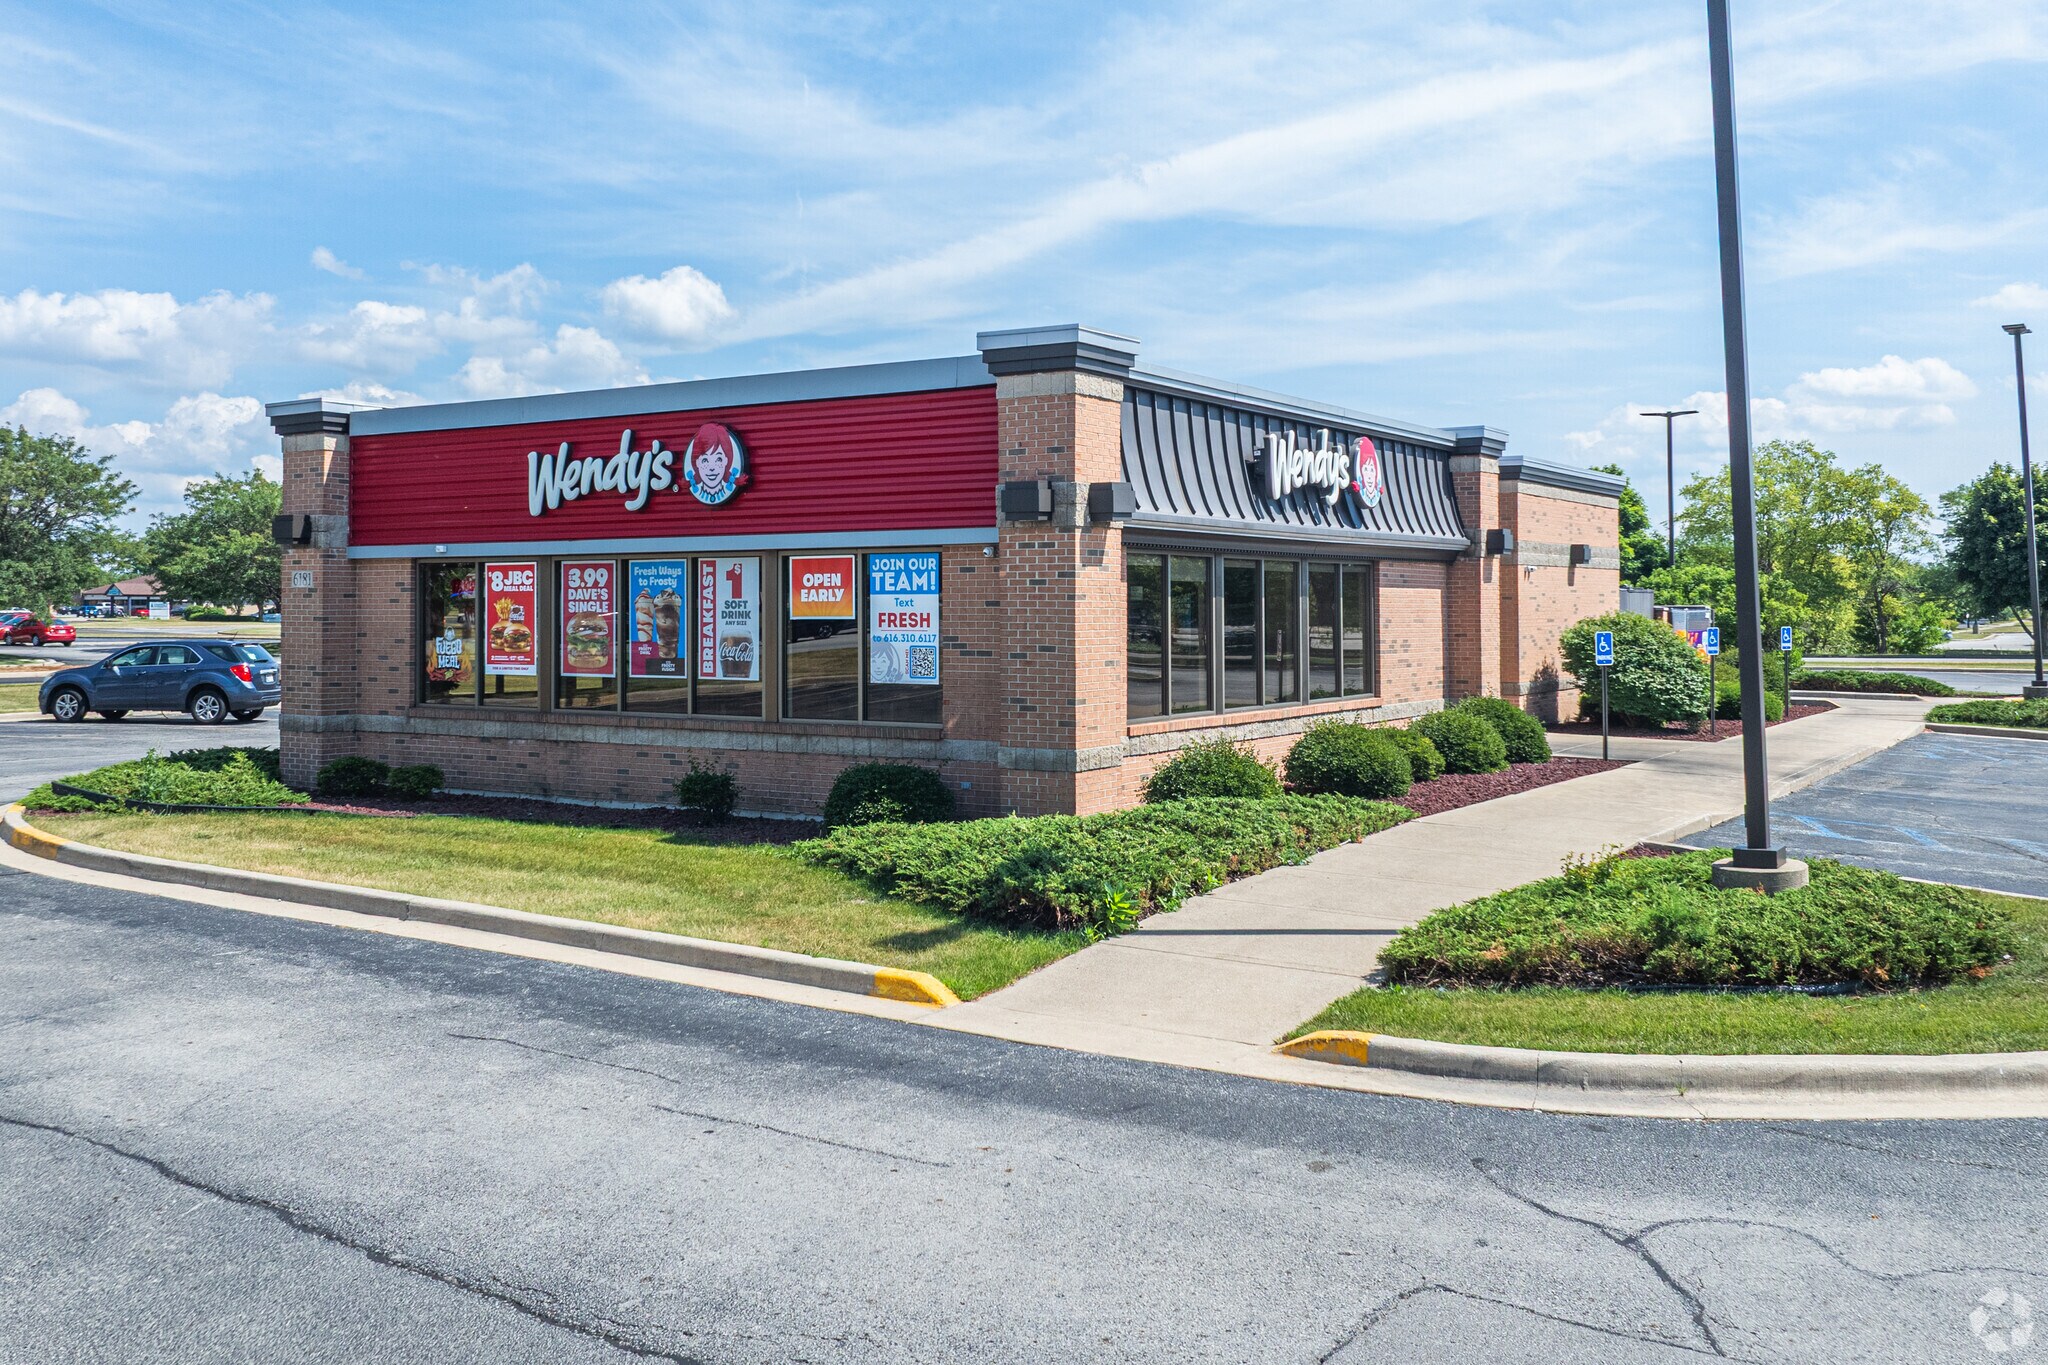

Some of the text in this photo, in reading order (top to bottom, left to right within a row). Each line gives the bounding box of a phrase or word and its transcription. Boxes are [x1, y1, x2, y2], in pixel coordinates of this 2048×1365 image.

[528, 429, 674, 517] Wendy's
[1266, 428, 1350, 505] Wendy's
[634, 566, 682, 577] Fresh Ways
[872, 558, 937, 571] JOIN OUR
[293, 572, 311, 586] 6181
[504, 570, 534, 585] JBC
[638, 577, 677, 588] to Frosty
[802, 573, 842, 587] OPEN
[872, 571, 936, 591] TEAM!
[568, 588, 609, 600] DAVE'S
[800, 588, 845, 602] EARLY
[568, 601, 609, 613] SINGLE
[724, 600, 748, 609] SOFT
[894, 597, 915, 607] Text
[702, 563, 714, 674] BREAKFAST
[721, 610, 752, 620] DRINK
[878, 612, 931, 628] FRESH
[872, 633, 937, 643] to 616.310.6117
[436, 637, 463, 654] FUEGO
[438, 655, 460, 669] MEAL
